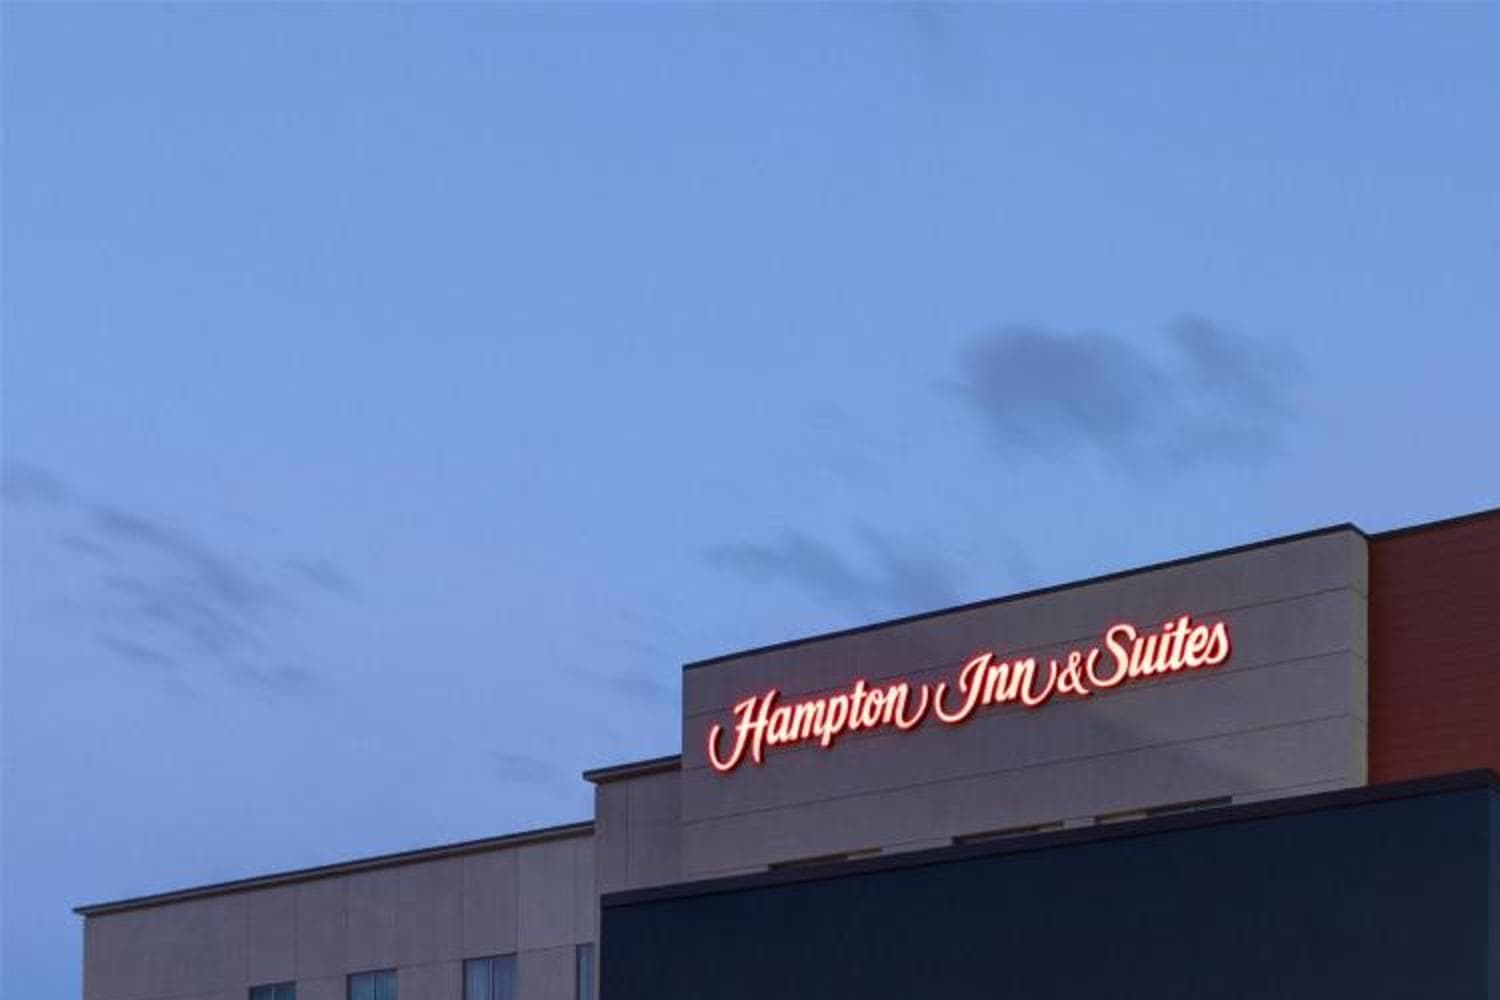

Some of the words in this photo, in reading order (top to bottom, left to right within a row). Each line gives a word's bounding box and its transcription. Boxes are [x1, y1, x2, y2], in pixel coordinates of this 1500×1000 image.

[709, 679, 929, 771] Hampton
[935, 652, 1057, 723] Inn
[1057, 651, 1089, 695] &
[1087, 615, 1229, 687] Suites
